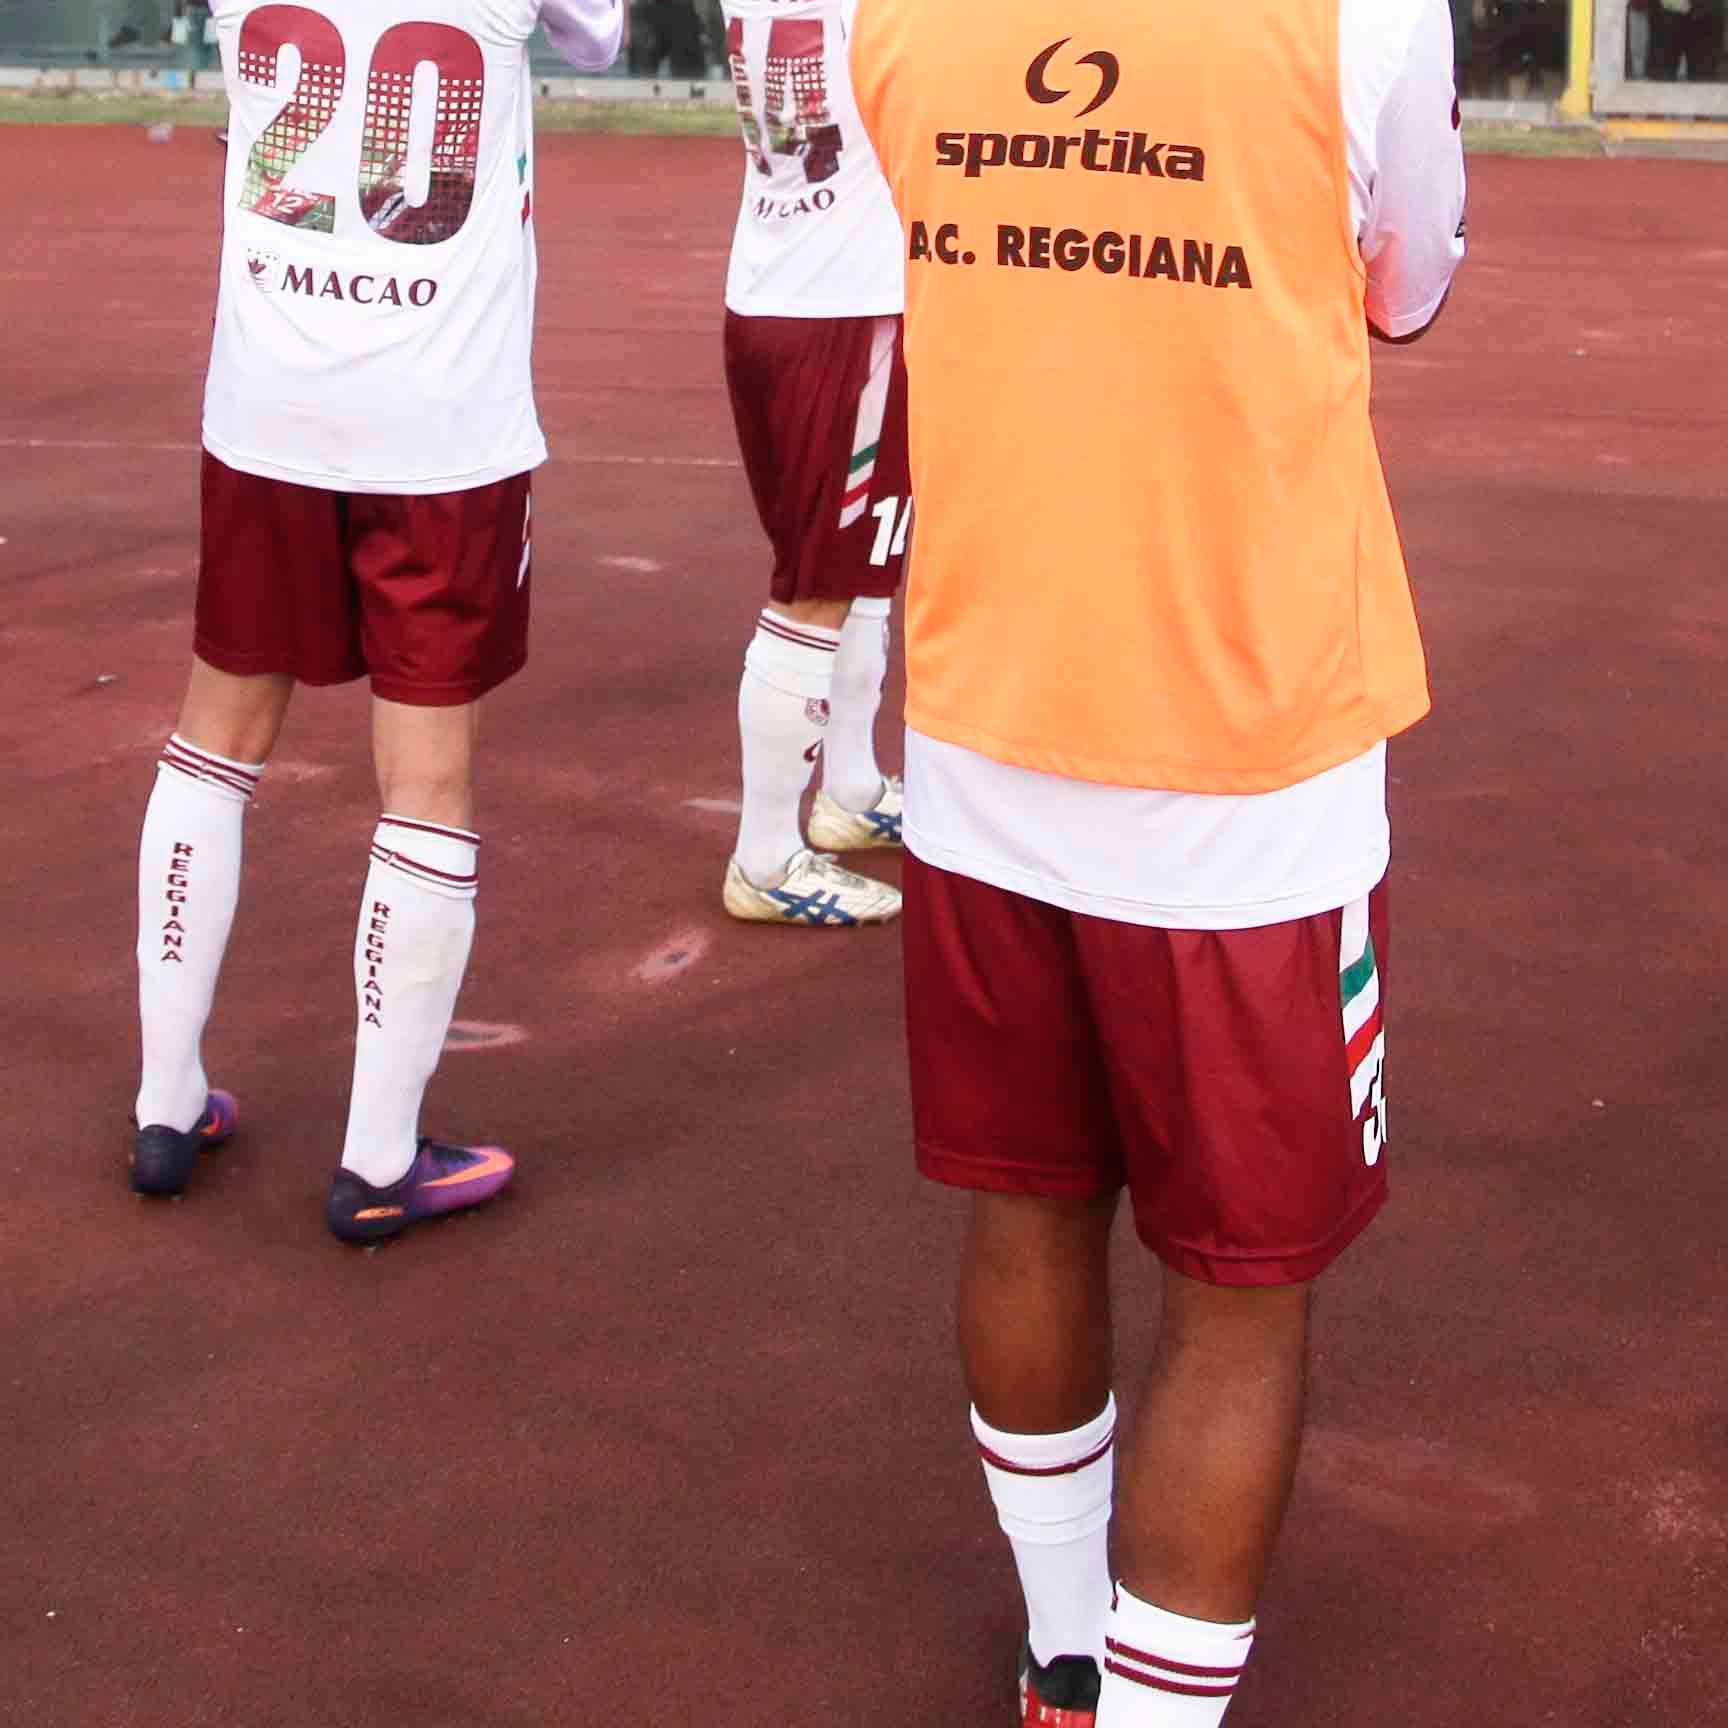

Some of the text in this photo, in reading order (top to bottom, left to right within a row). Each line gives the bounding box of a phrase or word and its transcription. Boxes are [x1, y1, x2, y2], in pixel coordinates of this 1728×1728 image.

[237, 4, 485, 247] 20
[935, 129, 1206, 182] sportika
[280, 263, 439, 308] MACAO
[997, 225, 1253, 289] REGGIANA
[161, 842, 194, 964] REGGIANA
[364, 901, 392, 1029] REGGIANA
